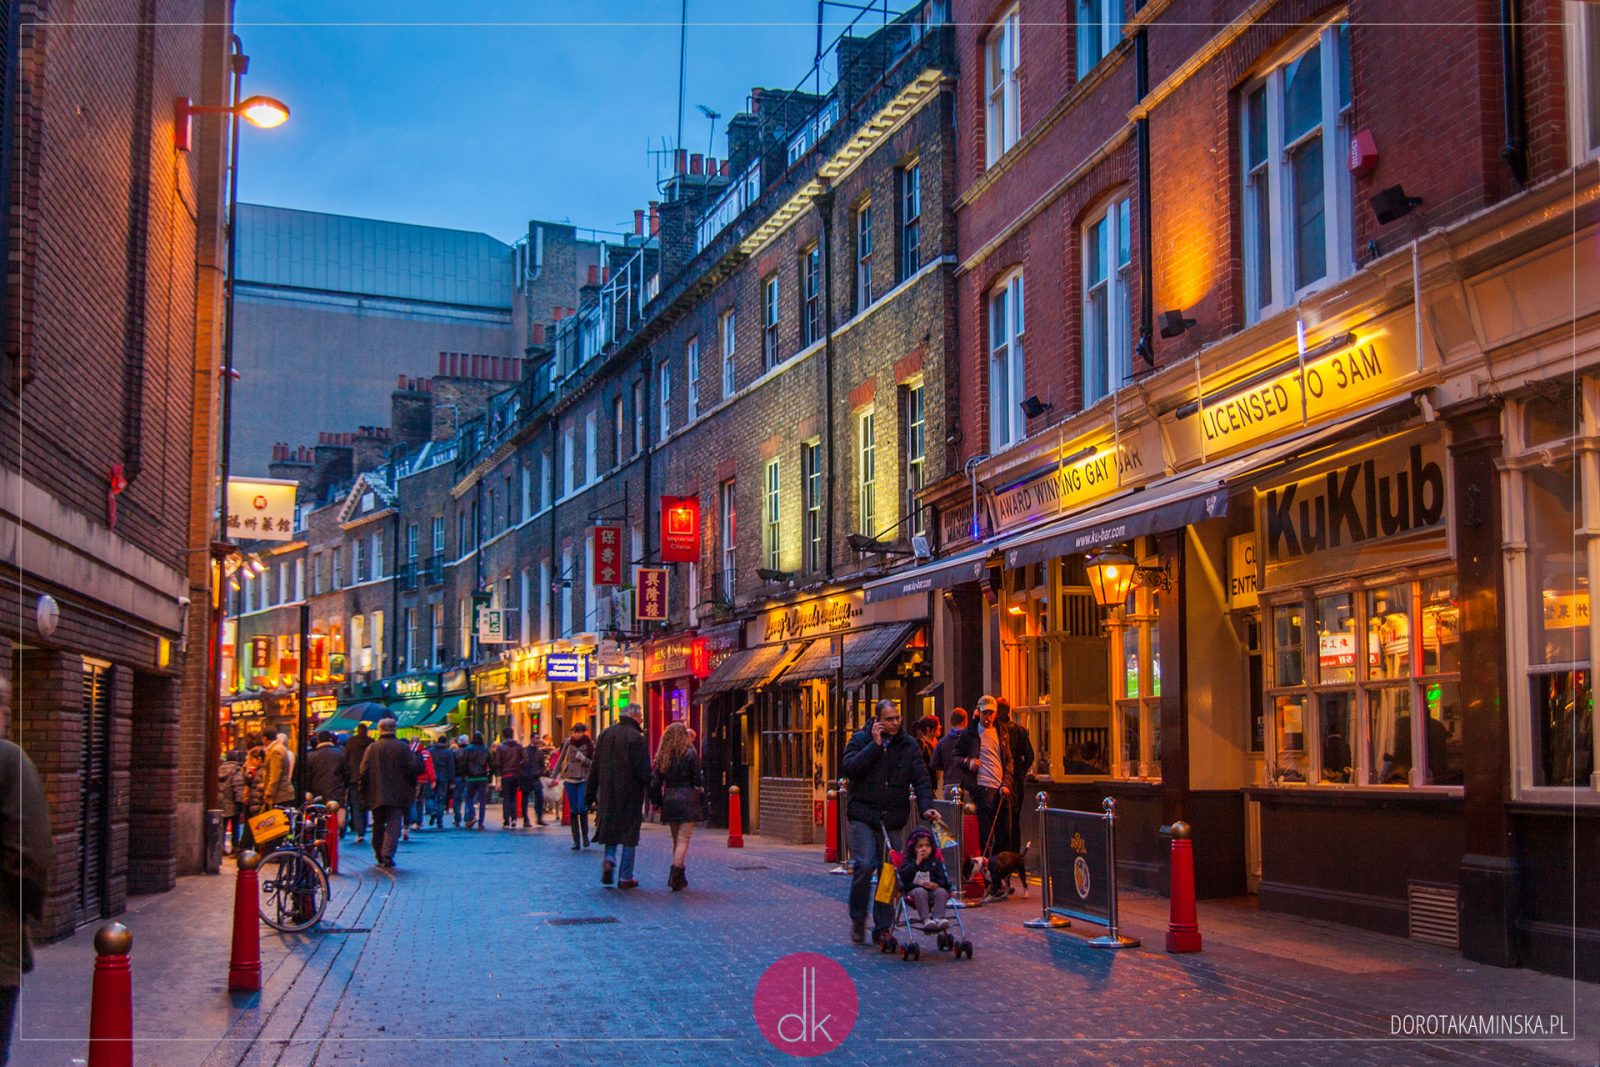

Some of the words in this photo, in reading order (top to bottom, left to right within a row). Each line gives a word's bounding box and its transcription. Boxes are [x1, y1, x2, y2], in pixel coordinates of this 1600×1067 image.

[1202, 384, 1289, 440] LICENSED
[1332, 344, 1382, 389] 3AM
[1001, 489, 1031, 521] AWARD
[1034, 468, 1082, 507] WINNING
[1085, 458, 1109, 486] GAY
[1267, 444, 1444, 561] KuKlub
[1075, 525, 1125, 548] www.ku-bar.com
